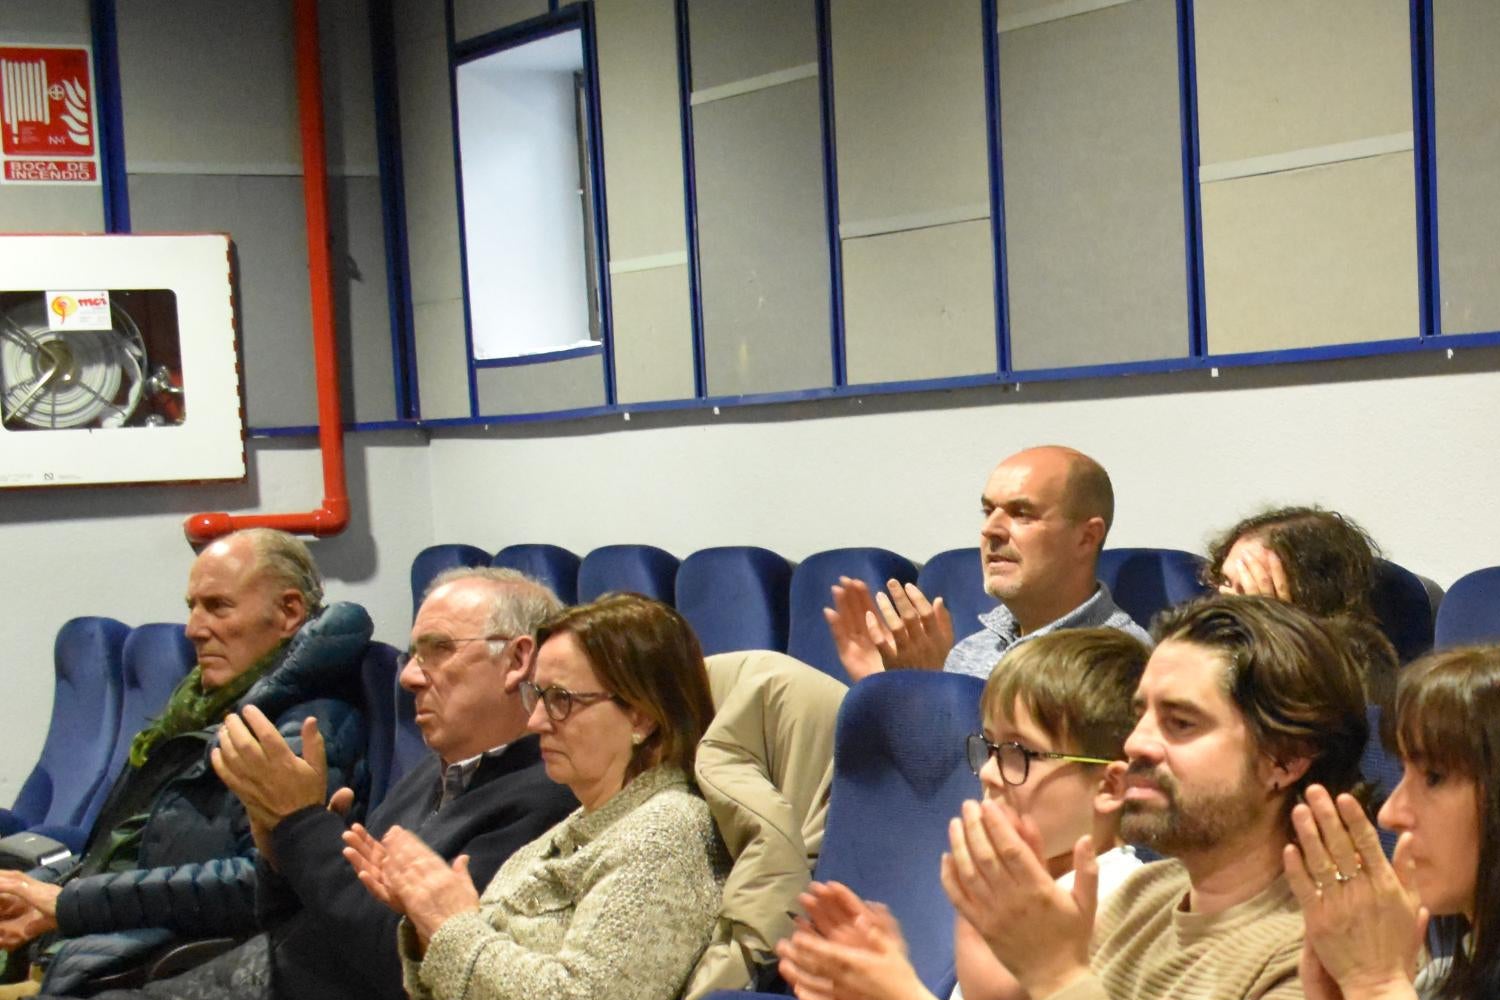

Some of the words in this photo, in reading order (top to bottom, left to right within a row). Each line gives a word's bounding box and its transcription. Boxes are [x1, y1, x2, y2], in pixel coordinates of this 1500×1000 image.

[10, 162, 60, 171] BOCA
[67, 162, 89, 171] DE
[11, 171, 91, 180] INCENDIO
